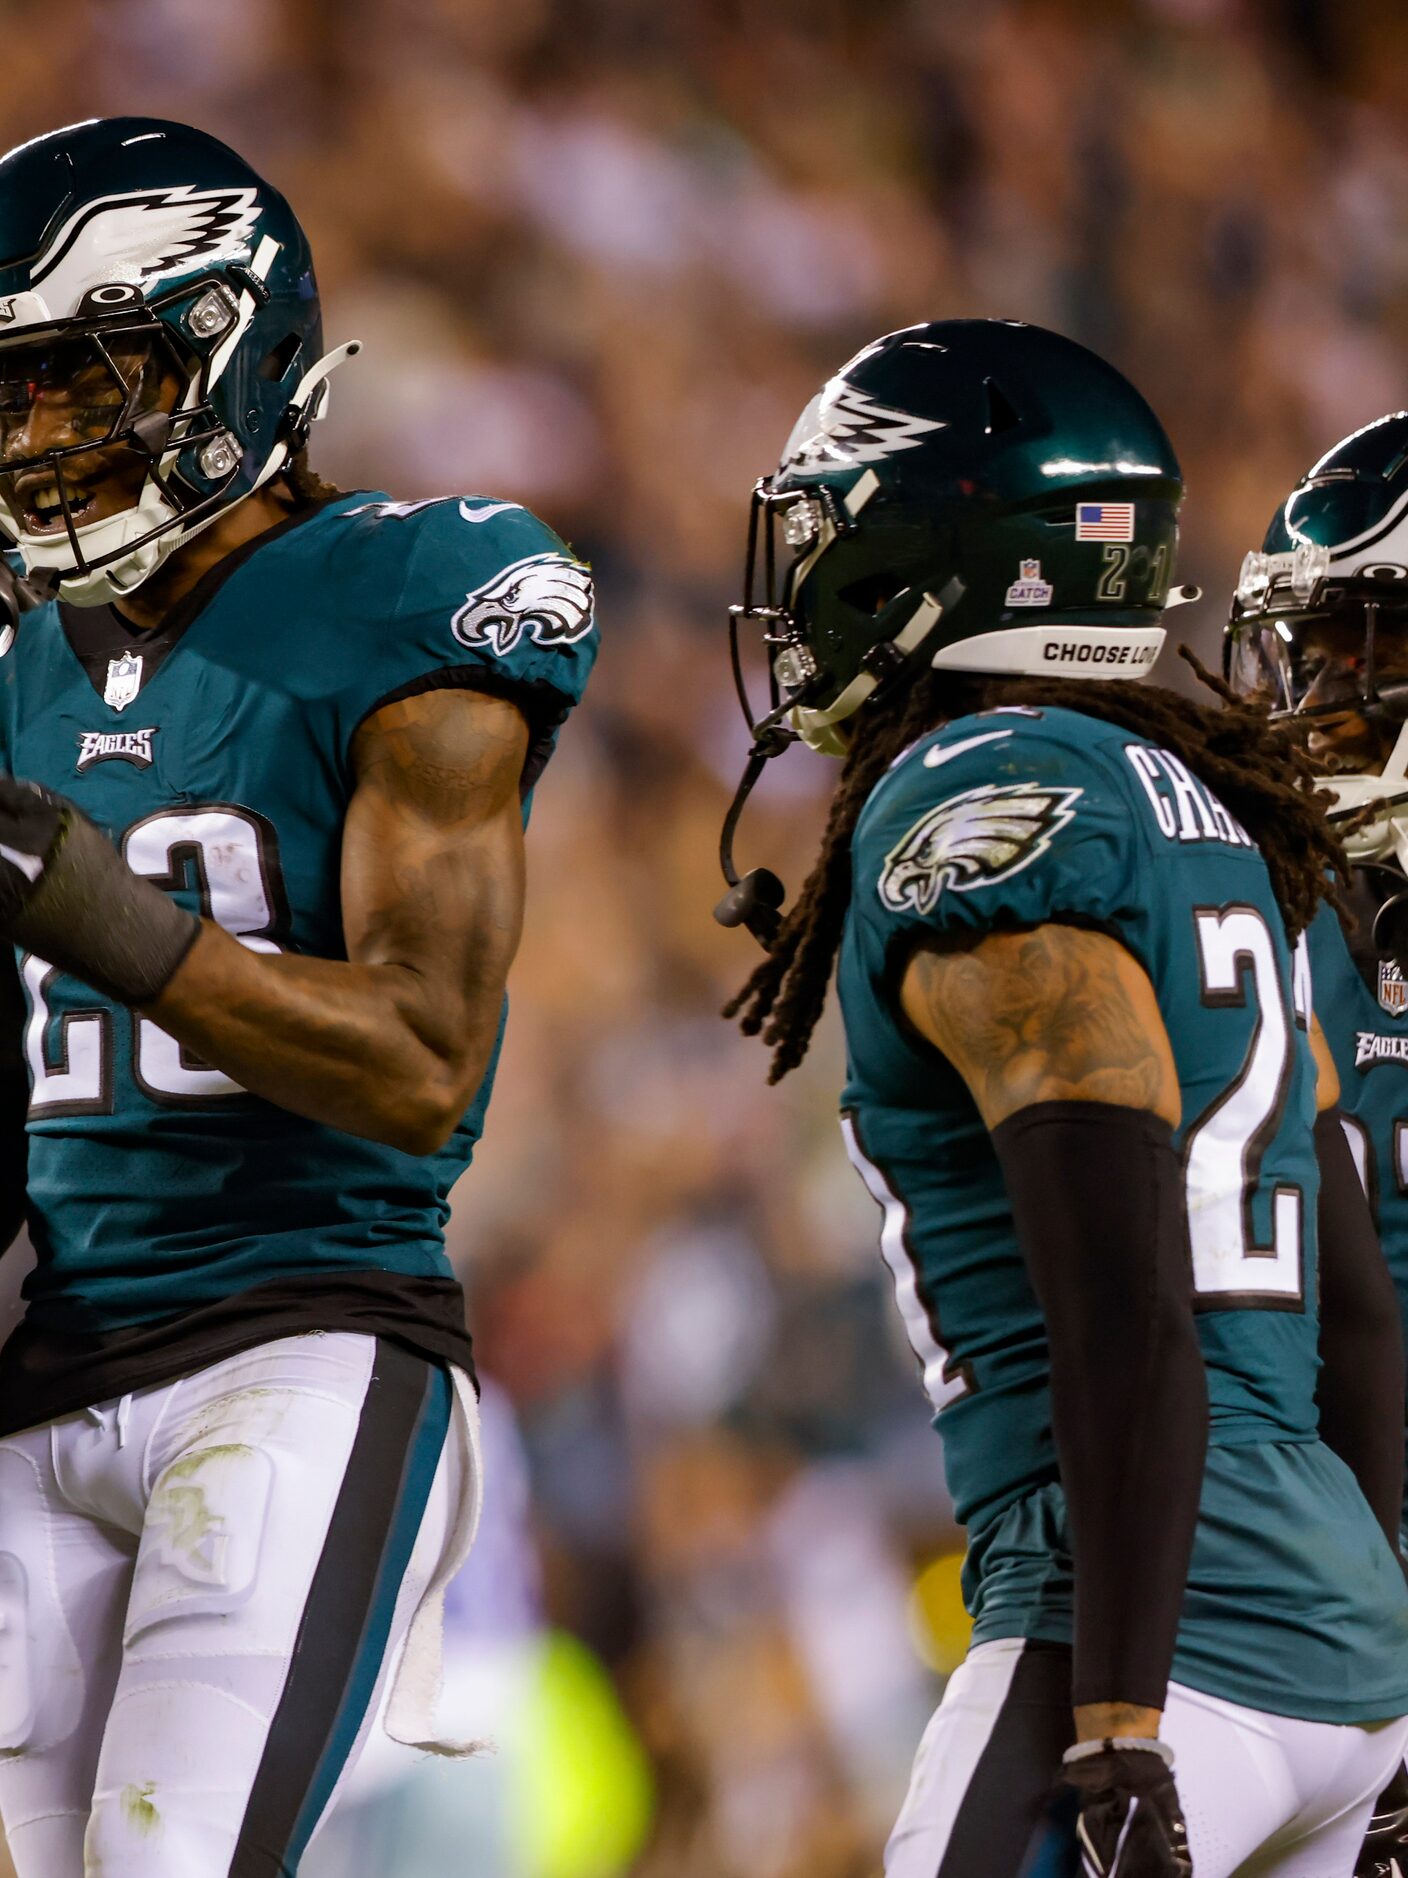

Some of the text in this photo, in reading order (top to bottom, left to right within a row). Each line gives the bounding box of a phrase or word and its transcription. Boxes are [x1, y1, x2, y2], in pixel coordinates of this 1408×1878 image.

[1095, 544, 1168, 602] 21
[1008, 586, 1049, 600] CATCH
[1043, 643, 1130, 664] CHOOSE
[76, 726, 159, 772] EAGLES
[1383, 982, 1406, 1005] NFL
